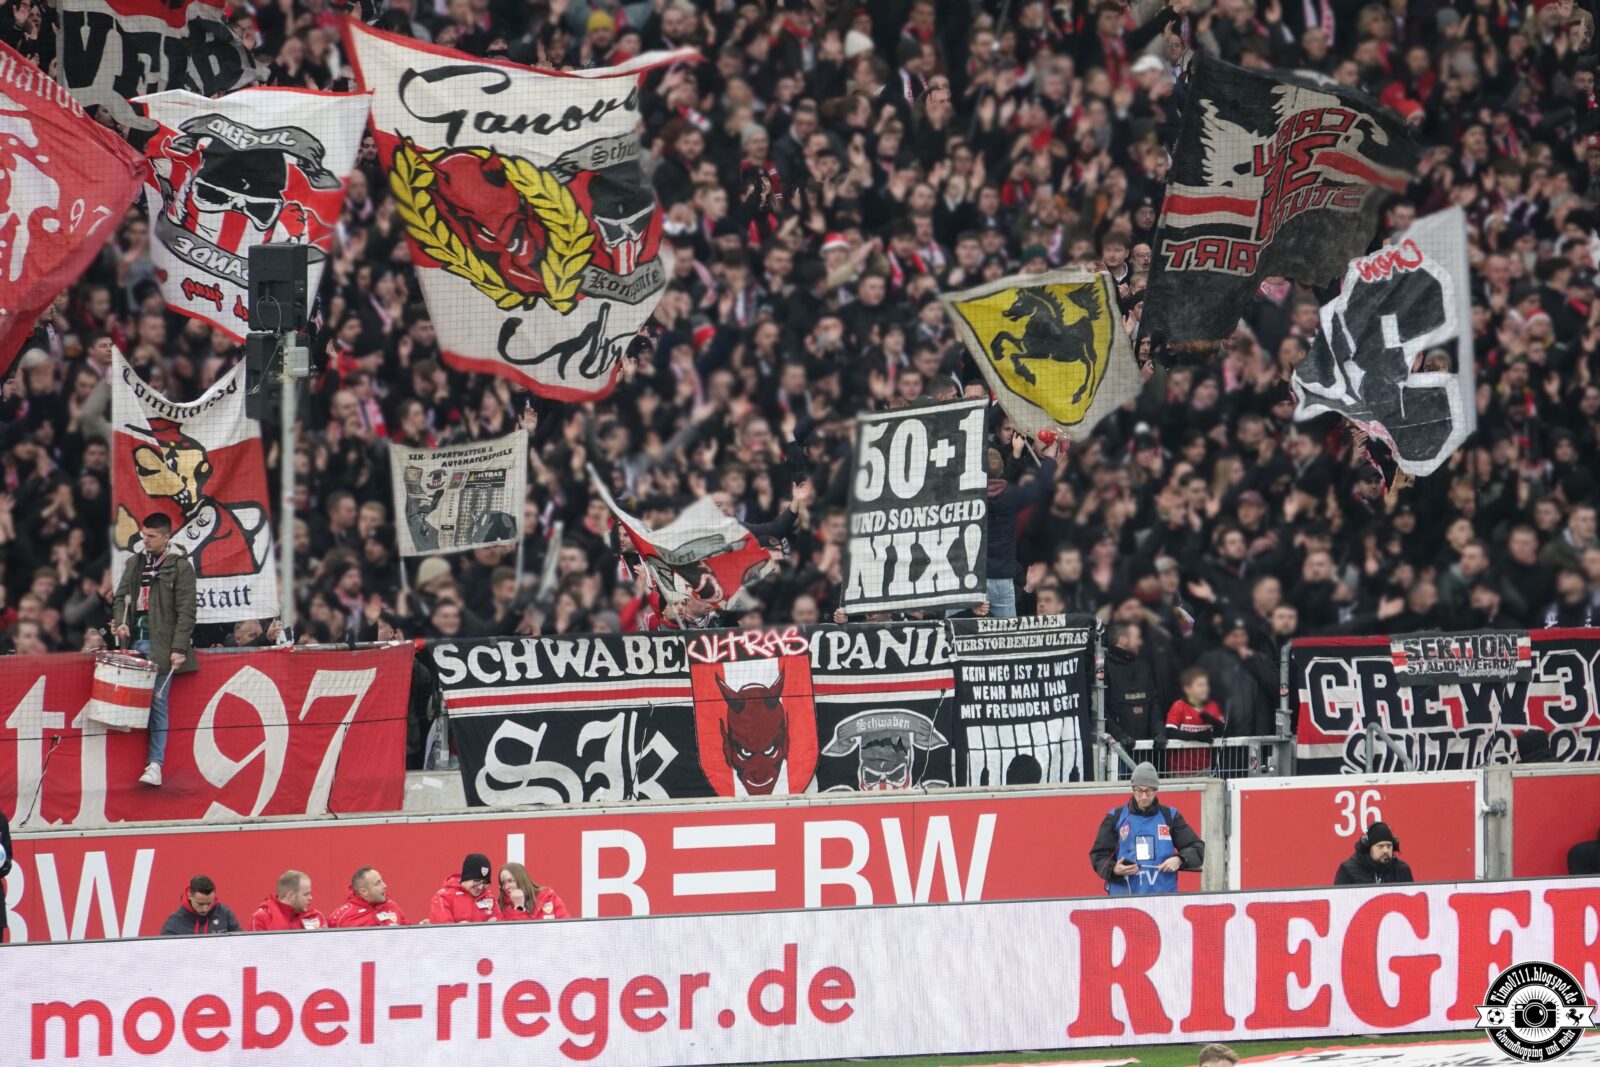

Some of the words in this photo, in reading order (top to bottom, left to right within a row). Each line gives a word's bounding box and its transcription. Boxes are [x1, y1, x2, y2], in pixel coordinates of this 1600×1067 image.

[69, 199, 113, 237] 97
[854, 408, 988, 502] 50+1
[851, 511, 886, 535] UND
[888, 499, 986, 531] SONSCHD
[845, 523, 983, 601] NIX!
[977, 617, 1018, 632] EHRE
[1019, 614, 1067, 630] ALLEN
[688, 626, 809, 663] ULTRAS
[955, 636, 1044, 652] VERSTORBENEN
[1046, 632, 1089, 646] ULTRAS
[1403, 634, 1519, 661] SEKTION
[962, 665, 986, 682] KEIN
[988, 664, 1010, 682] WEG
[1014, 663, 1033, 680] IST
[1038, 663, 1050, 679] ZU
[1054, 658, 1080, 676] WEIT
[961, 704, 982, 719] MIT
[986, 701, 1050, 719] FREUNDEN
[1053, 694, 1080, 712] GEHT
[973, 685, 1006, 701] WENN
[1011, 683, 1039, 699] MAN
[1540, 650, 1600, 729] 3
[856, 715, 911, 732] Schwaben
[192, 665, 378, 820] 97
[1334, 790, 1382, 838] 36
[1136, 870, 1159, 886] TV
[30, 942, 857, 1063] moebel-rieger.de
